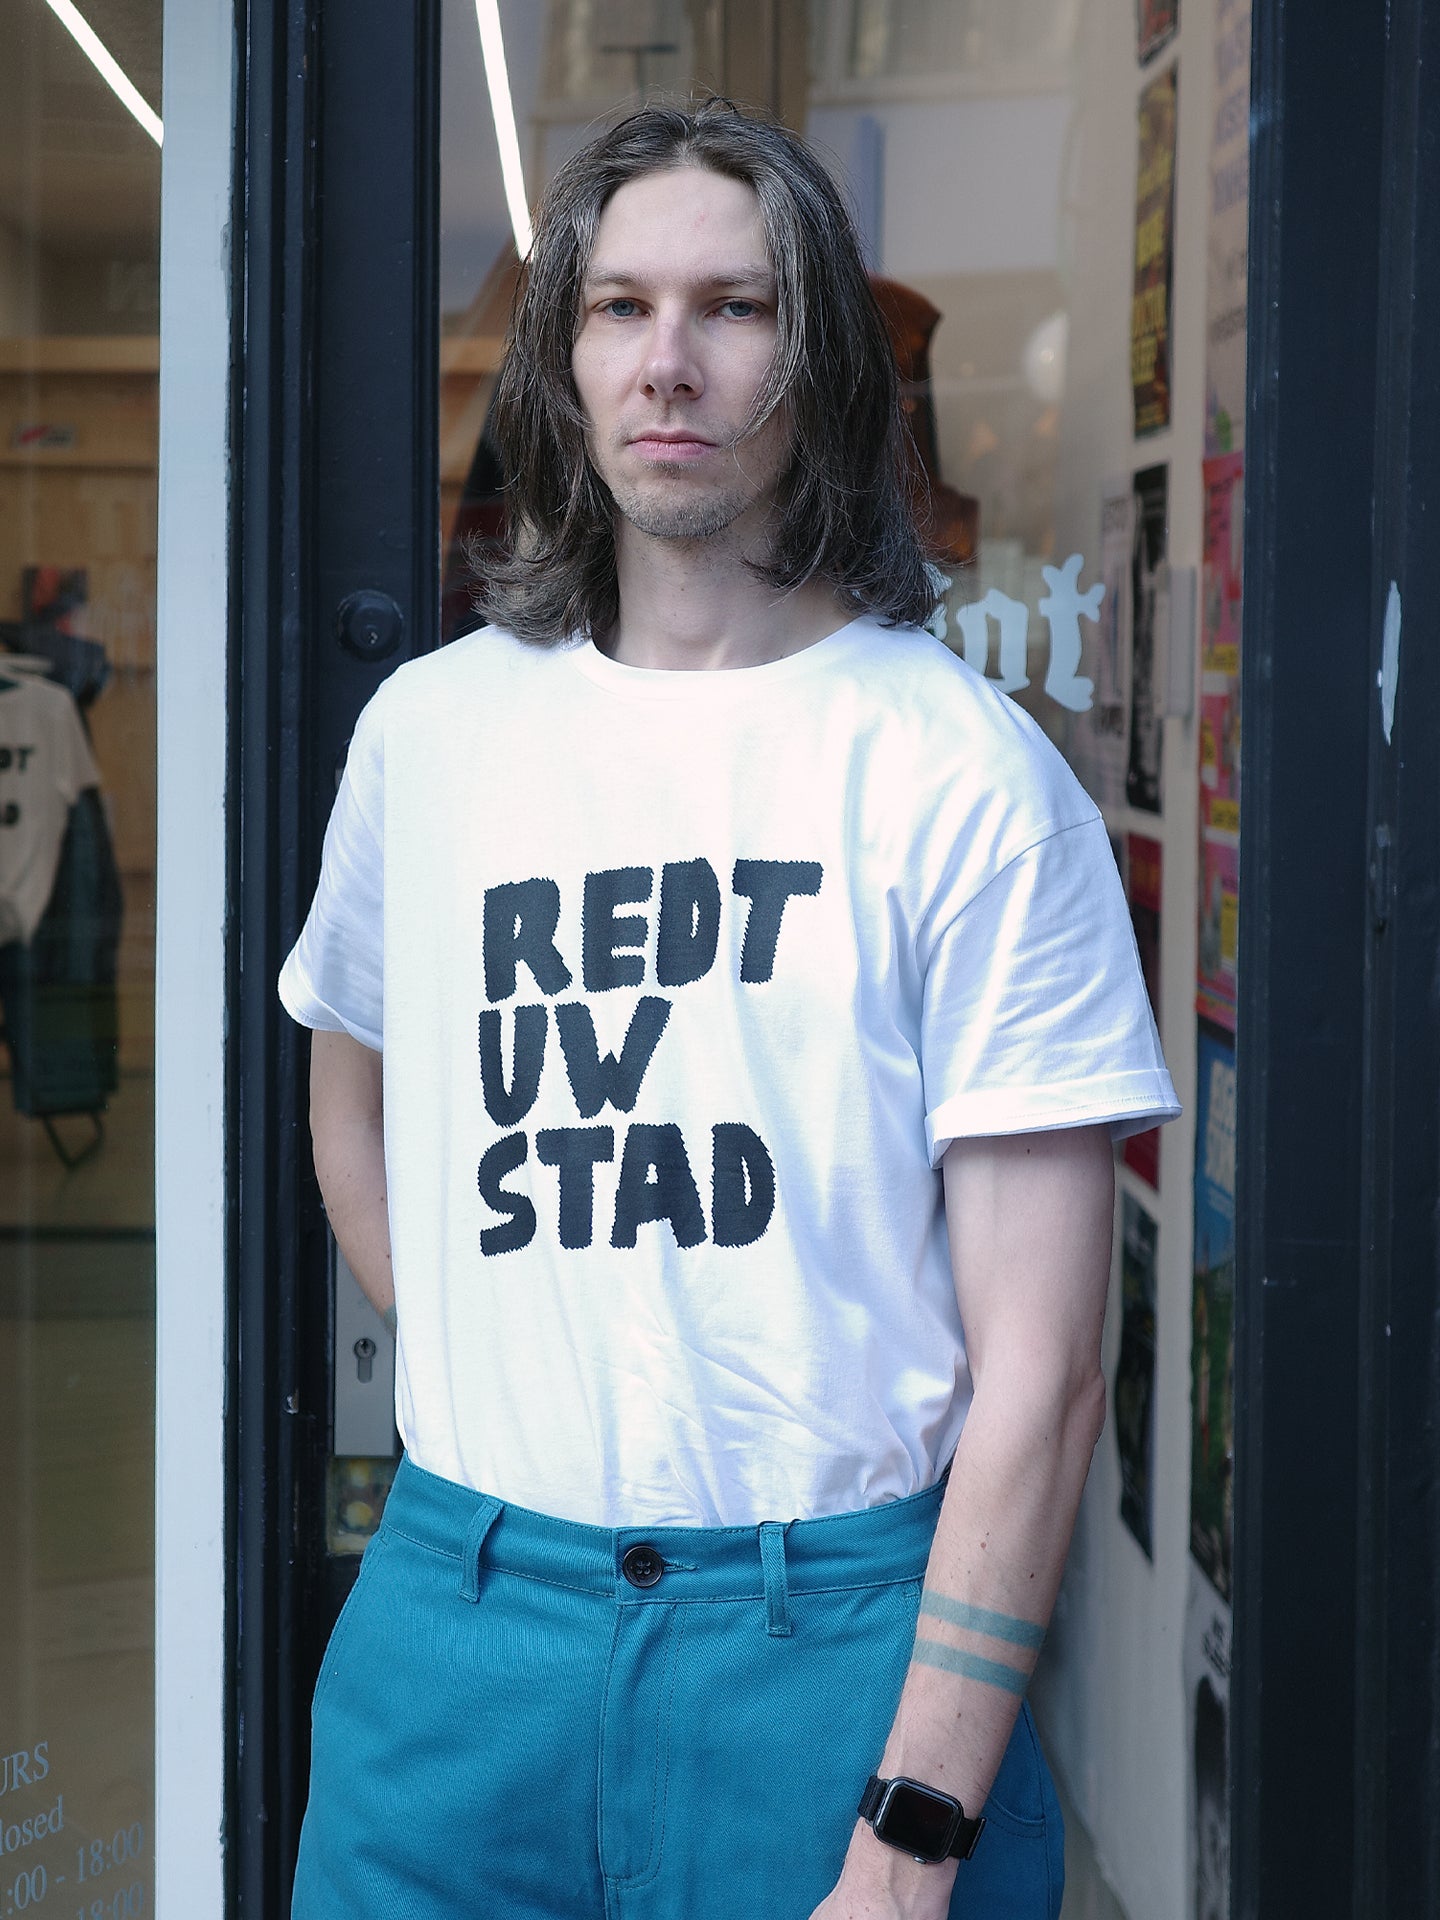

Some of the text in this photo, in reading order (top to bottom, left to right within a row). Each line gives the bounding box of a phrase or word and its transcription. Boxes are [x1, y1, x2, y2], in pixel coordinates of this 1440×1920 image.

[922, 553, 1106, 712] nt
[482, 857, 824, 1003] REDT
[478, 995, 673, 1128] UW
[477, 1122, 776, 1257] STAD
[76, 1822, 144, 1884] 18:00
